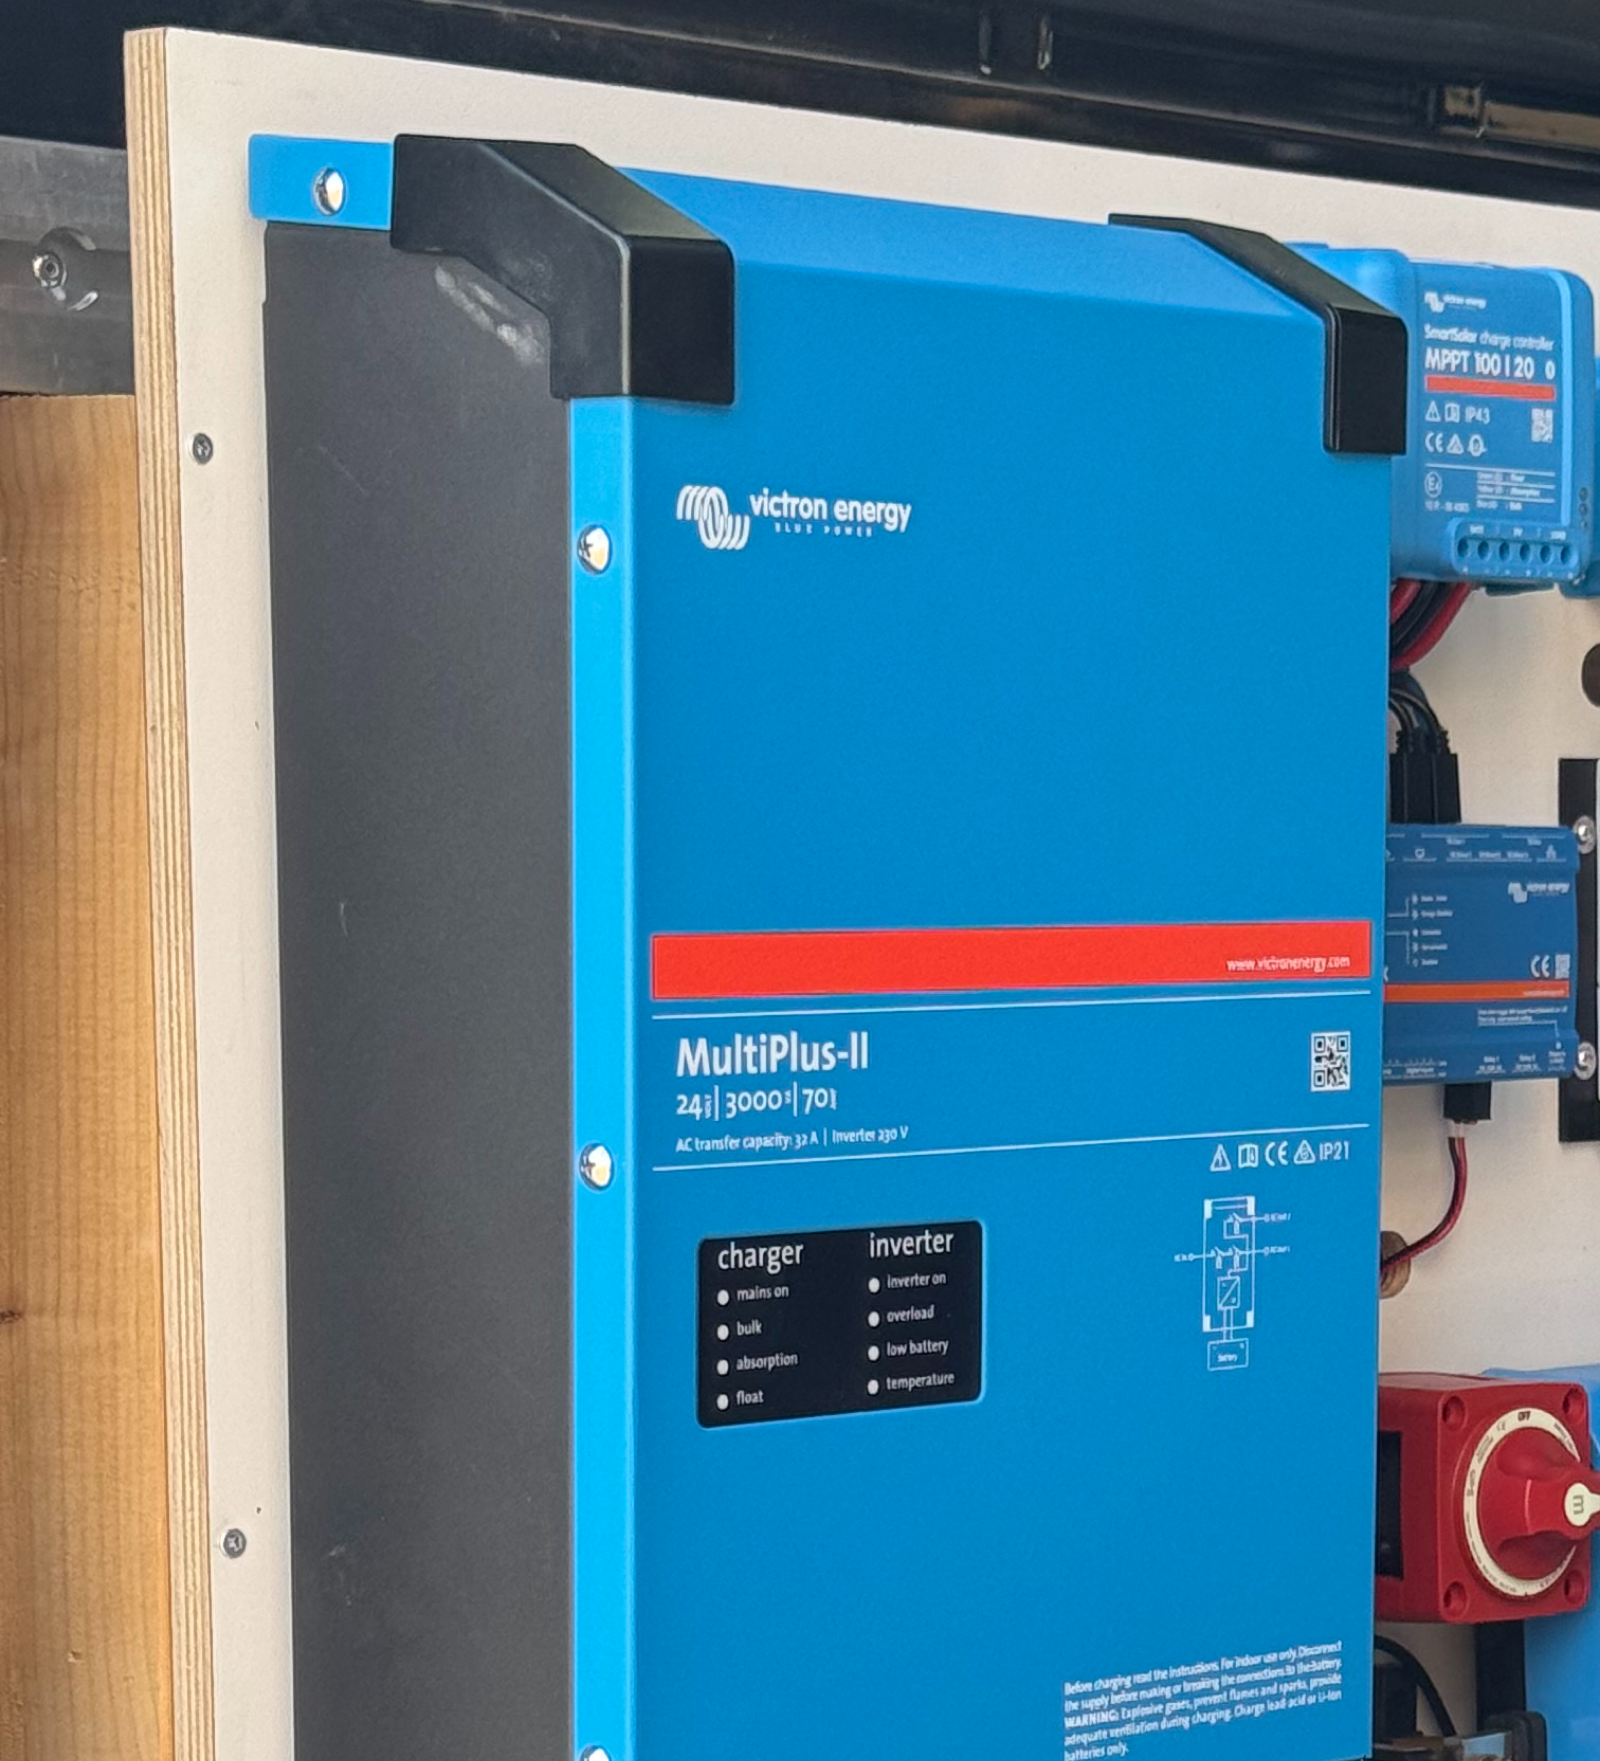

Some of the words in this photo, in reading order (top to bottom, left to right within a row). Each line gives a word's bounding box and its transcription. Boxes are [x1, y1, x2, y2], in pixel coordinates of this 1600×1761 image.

[1424, 323, 1477, 343] SmartSolar
[1425, 347, 1470, 373] MPPT
[1474, 351, 1501, 377] 100
[1514, 355, 1535, 380] 20
[1465, 406, 1490, 424] IP43
[749, 487, 828, 521] victron
[834, 499, 911, 533] energy
[1226, 956, 1351, 973] www.victronenergy.com
[676, 1030, 869, 1077] MultiPlus-II
[676, 1137, 694, 1152] AC
[695, 1133, 740, 1151] transfer
[742, 1131, 793, 1152] capacity:
[794, 1134, 808, 1151] 32
[809, 1131, 819, 1145] A
[832, 1127, 876, 1144] Inverter
[878, 1127, 898, 1144] 230
[900, 1125, 909, 1140] V
[1319, 1141, 1350, 1161] IP21
[868, 1229, 955, 1259] inverter
[717, 1242, 804, 1274] charger
[886, 1273, 930, 1289] inverter
[931, 1273, 947, 1286] on
[736, 1286, 771, 1301] mains
[774, 1285, 789, 1298] on
[886, 1304, 935, 1323] overload
[736, 1320, 762, 1336] bulk
[886, 1342, 907, 1357] low
[909, 1339, 949, 1357] battery
[736, 1352, 799, 1372] absorption
[886, 1372, 955, 1392] temperature
[736, 1390, 764, 1406] float
[1517, 1410, 1531, 1422] OFF
